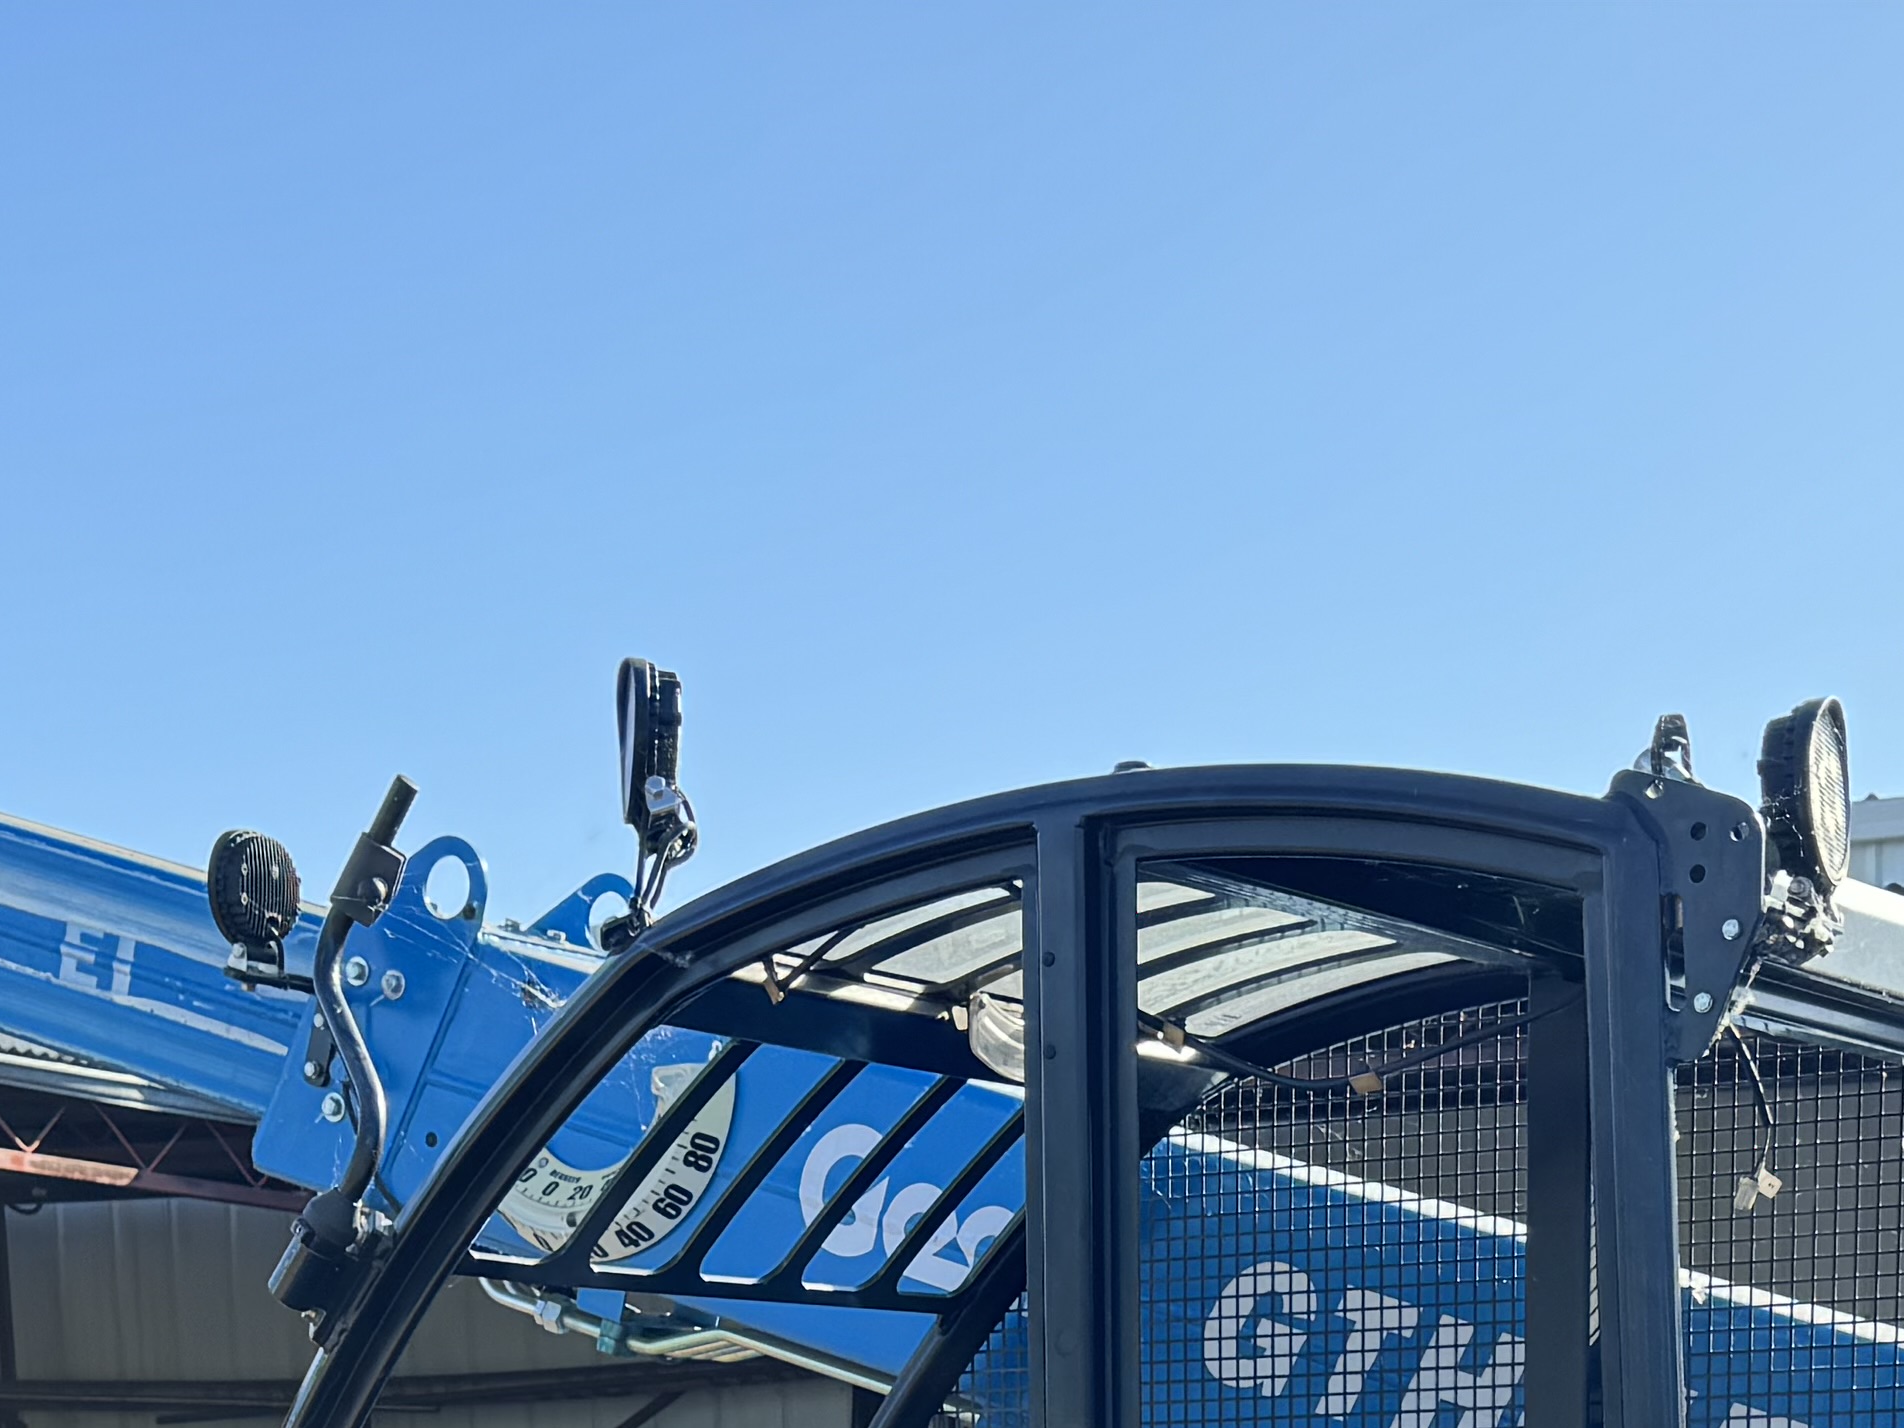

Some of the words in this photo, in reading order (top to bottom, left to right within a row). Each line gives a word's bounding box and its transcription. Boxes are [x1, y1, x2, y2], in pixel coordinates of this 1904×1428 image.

[682, 1131, 720, 1173] 80
[567, 1184, 594, 1201] 20
[652, 1183, 694, 1220] 60
[614, 1221, 655, 1249] 40
